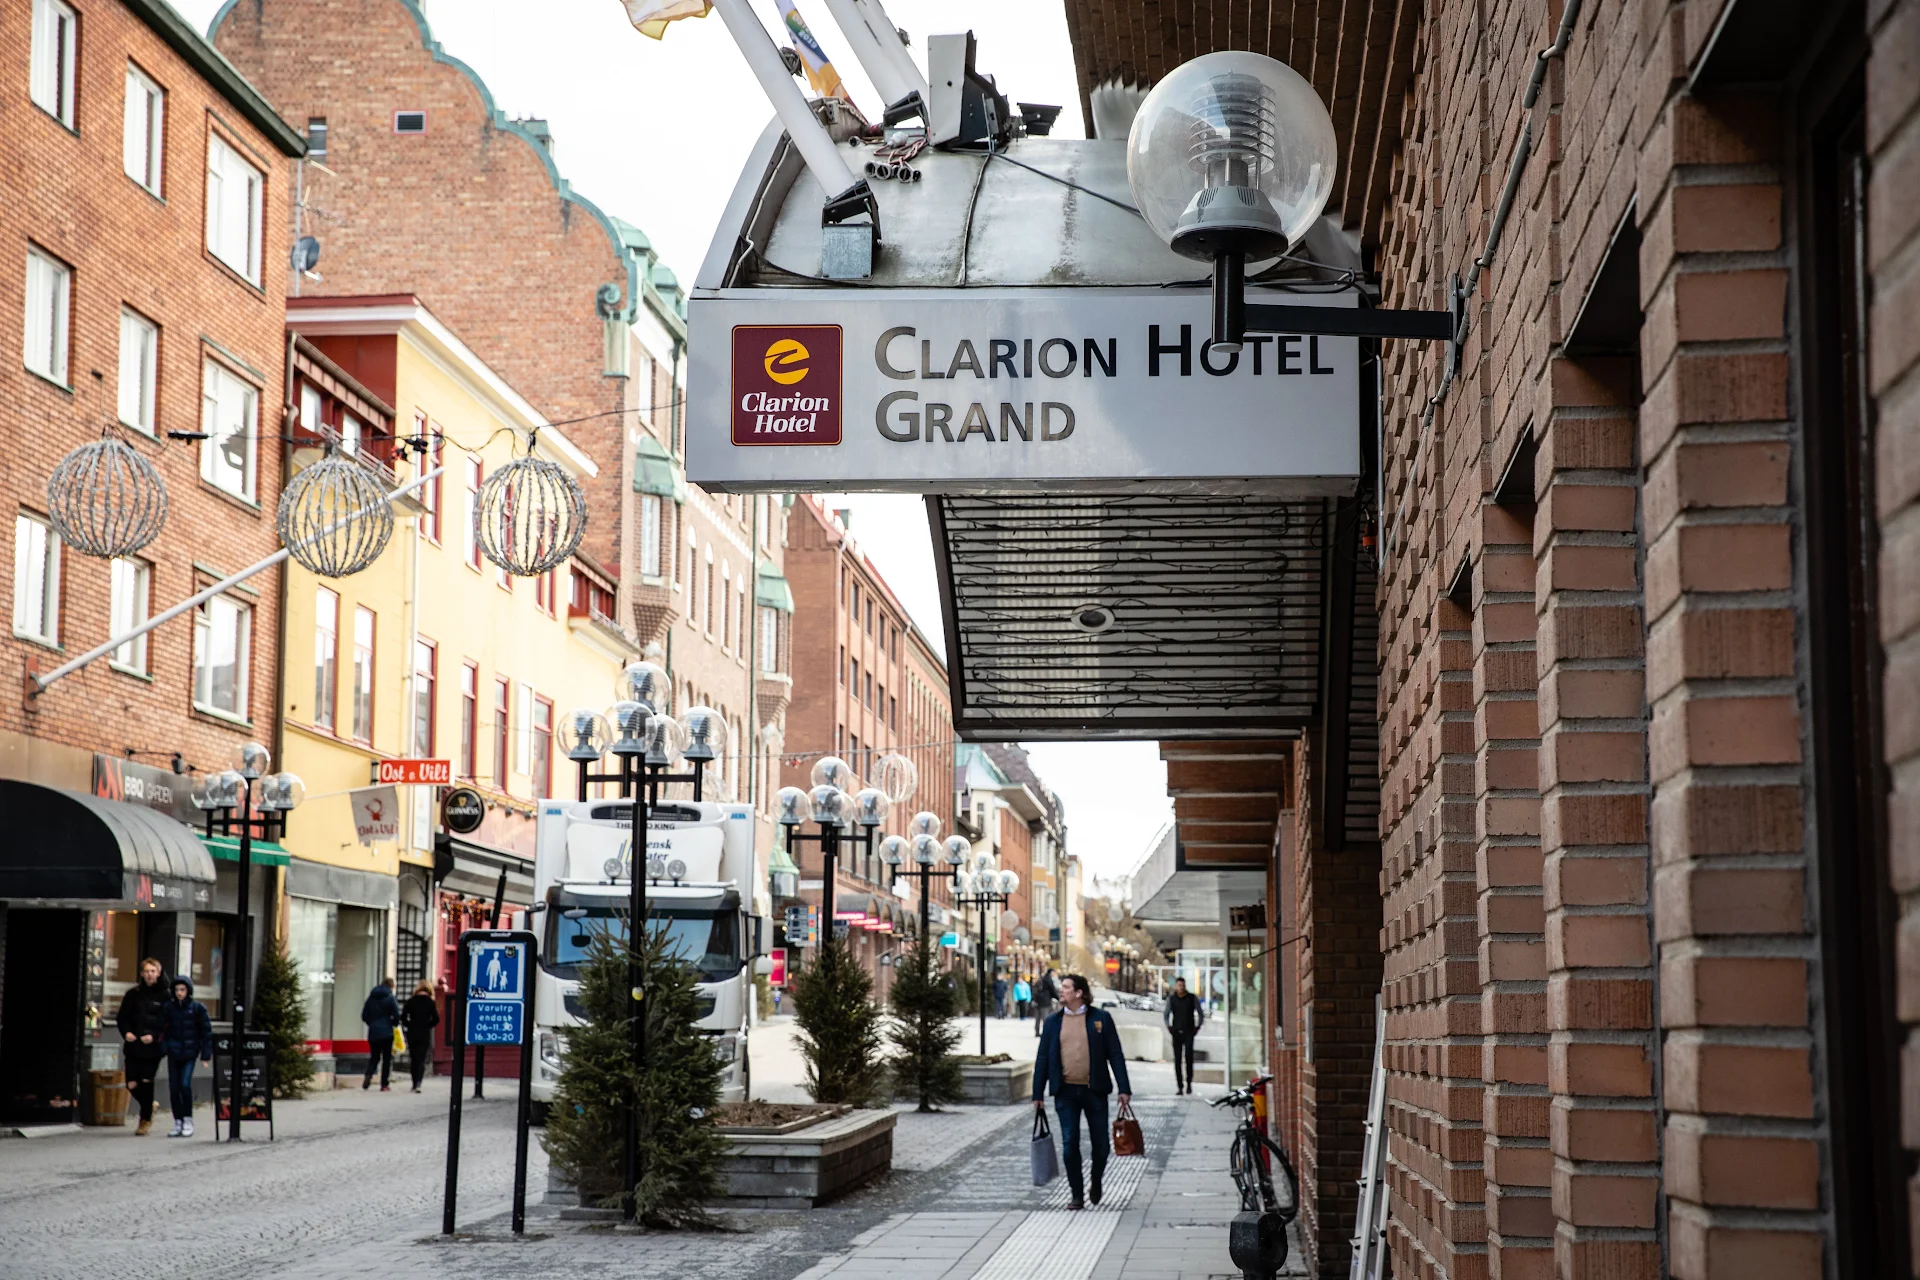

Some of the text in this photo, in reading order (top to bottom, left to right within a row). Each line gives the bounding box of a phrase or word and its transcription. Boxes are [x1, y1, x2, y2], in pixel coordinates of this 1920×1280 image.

[875, 324, 1334, 380] CLARION HOTEL
[741, 392, 830, 433] Clarion Hotel
[876, 391, 1076, 442] GRAND
[382, 763, 405, 781] Ost
[419, 763, 449, 781] Vilt
[125, 775, 173, 804] BBQ GARDEN
[446, 806, 480, 815] GUINNESS
[646, 839, 672, 849] ensk
[646, 852, 669, 861] ater
[478, 1004, 514, 1013] Varutrp
[475, 1033, 514, 1041] 16.30-20
